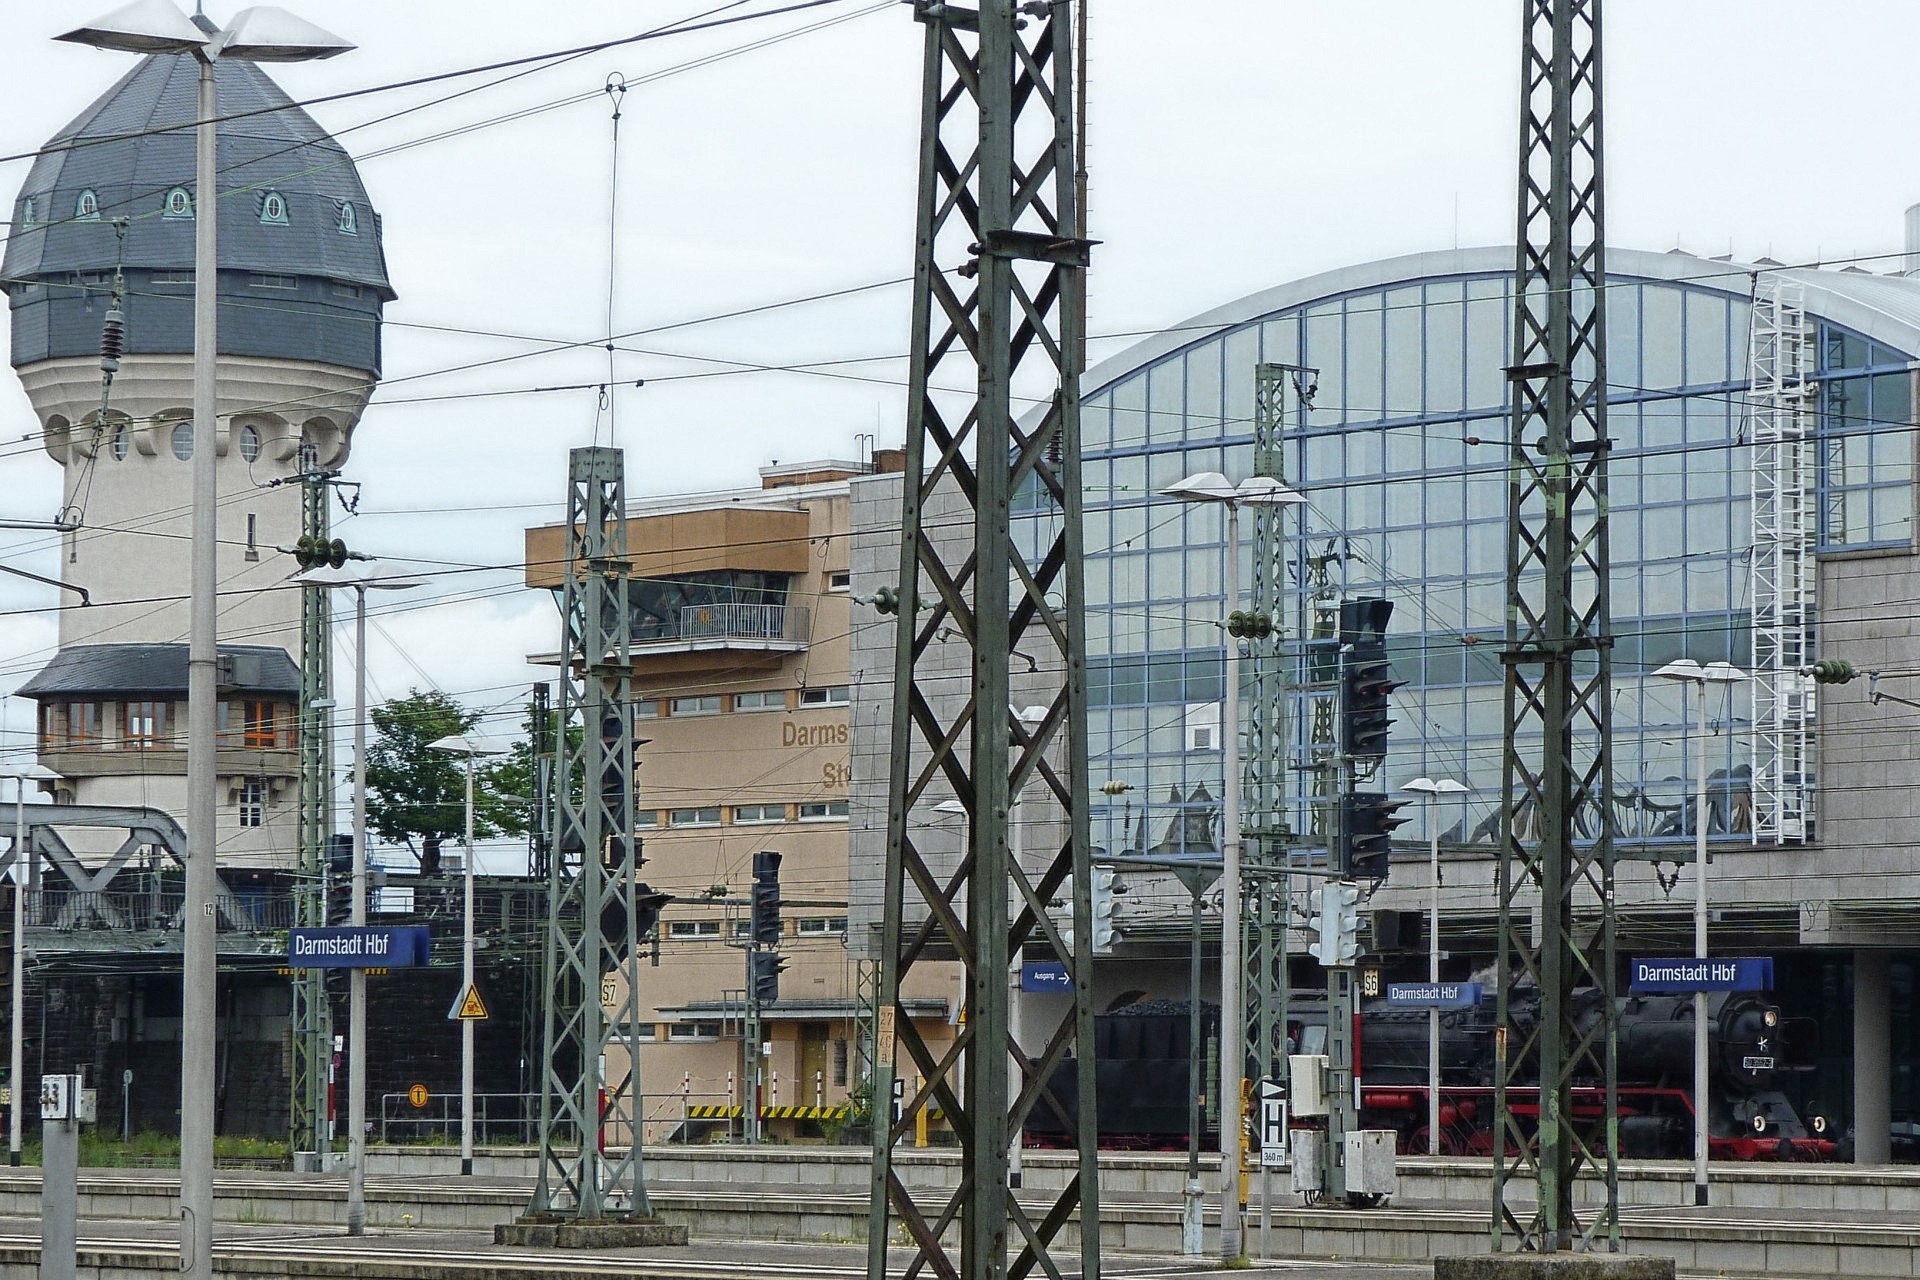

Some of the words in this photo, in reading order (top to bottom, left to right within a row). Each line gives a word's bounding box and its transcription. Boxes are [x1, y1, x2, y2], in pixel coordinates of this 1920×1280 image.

[782, 721, 848, 747] Darms
[823, 762, 849, 789] St
[205, 903, 212, 915] 12
[295, 934, 362, 955] Darmstadt
[365, 933, 389, 955] Hbf
[1034, 972, 1055, 981] Ausgang
[1638, 964, 1708, 981] Darmstadt
[1711, 963, 1736, 981] Hbf
[1365, 975, 1377, 991] S6
[602, 984, 616, 1002] S7
[1391, 987, 1440, 1000] Darmstadt
[1441, 986, 1459, 999] Hbf
[1264, 1103, 1284, 1143] H
[1263, 1152, 1276, 1162] 360
[1276, 1154, 1284, 1162] m
